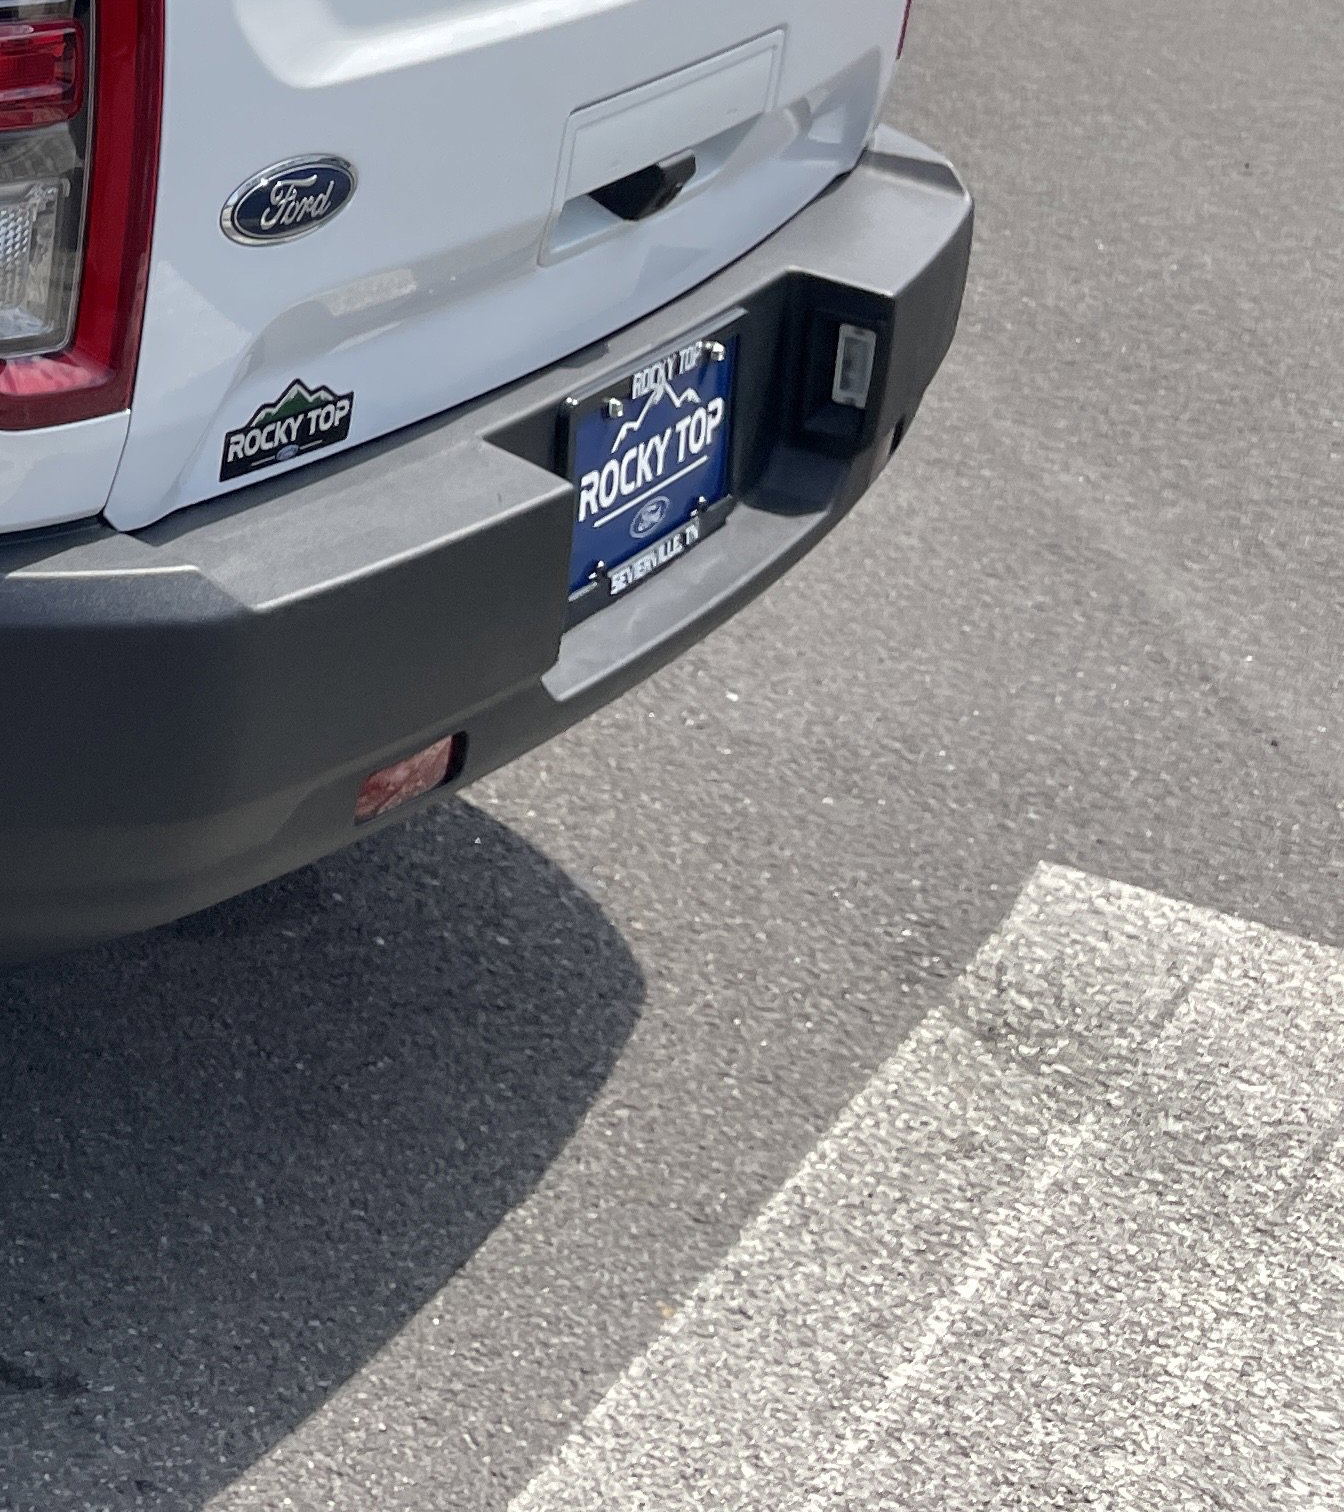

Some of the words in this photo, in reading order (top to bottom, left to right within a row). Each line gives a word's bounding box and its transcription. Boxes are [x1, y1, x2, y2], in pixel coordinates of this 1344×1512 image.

[260, 174, 335, 230] Ford
[226, 412, 305, 463] ROCKY
[307, 399, 351, 440] TOP
[578, 427, 672, 522] ROCKY
[675, 397, 725, 463] TOP
